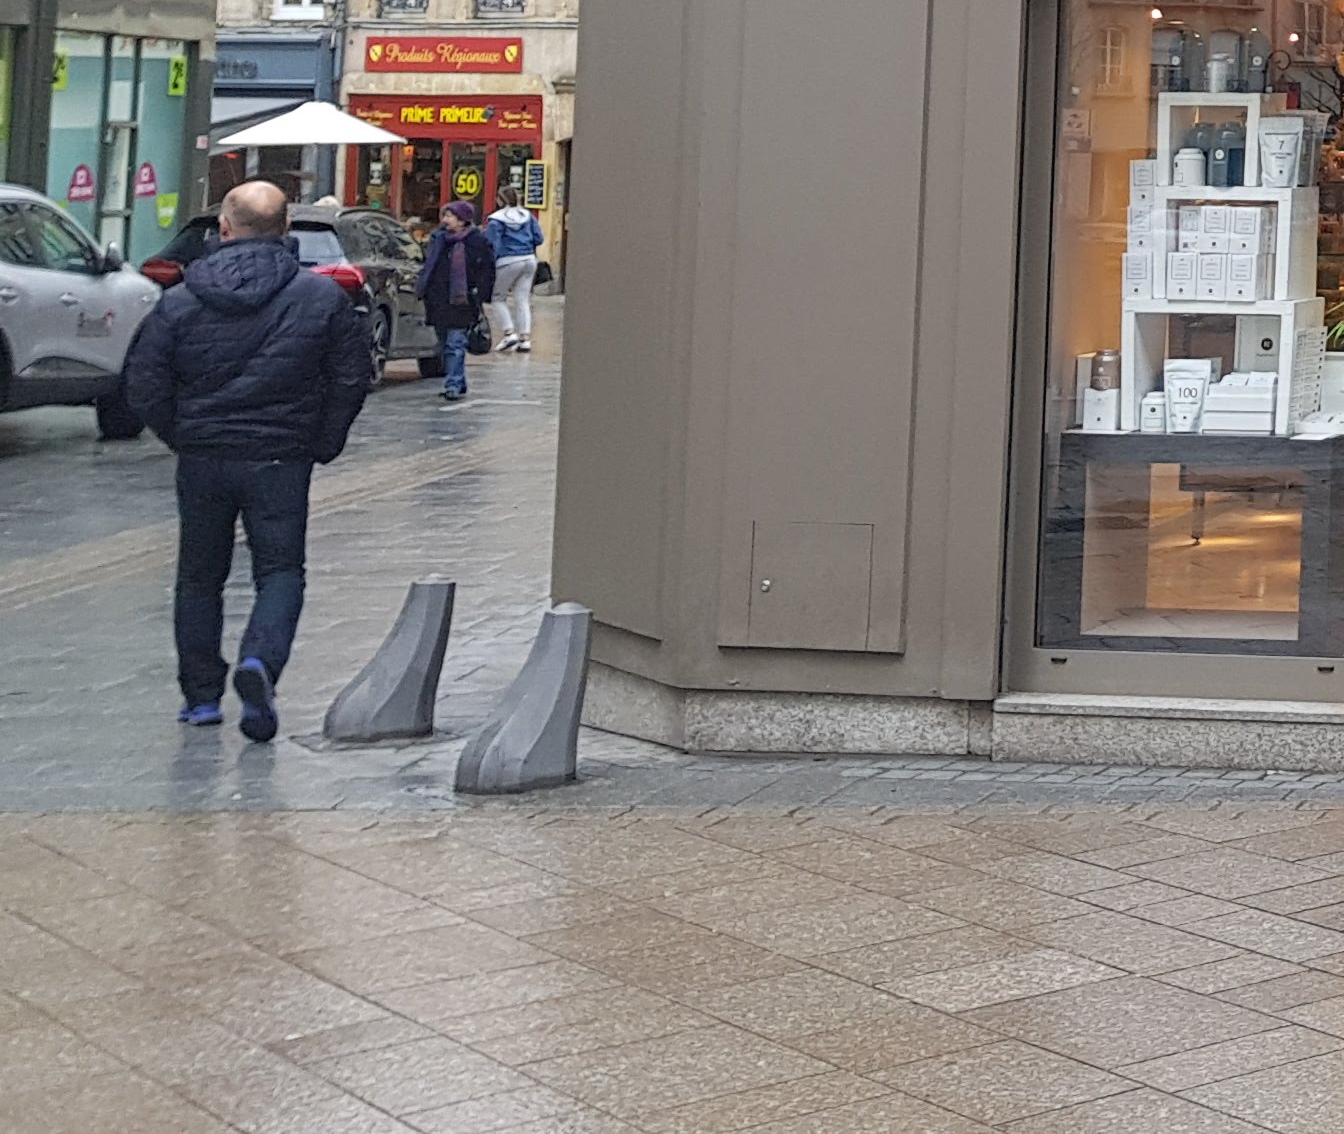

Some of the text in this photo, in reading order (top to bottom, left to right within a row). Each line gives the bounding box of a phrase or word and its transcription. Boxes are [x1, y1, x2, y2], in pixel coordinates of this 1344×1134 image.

[385, 42, 501, 69] Produits Régionaux
[456, 174, 478, 194] 50
[1178, 387, 1198, 398] 100
